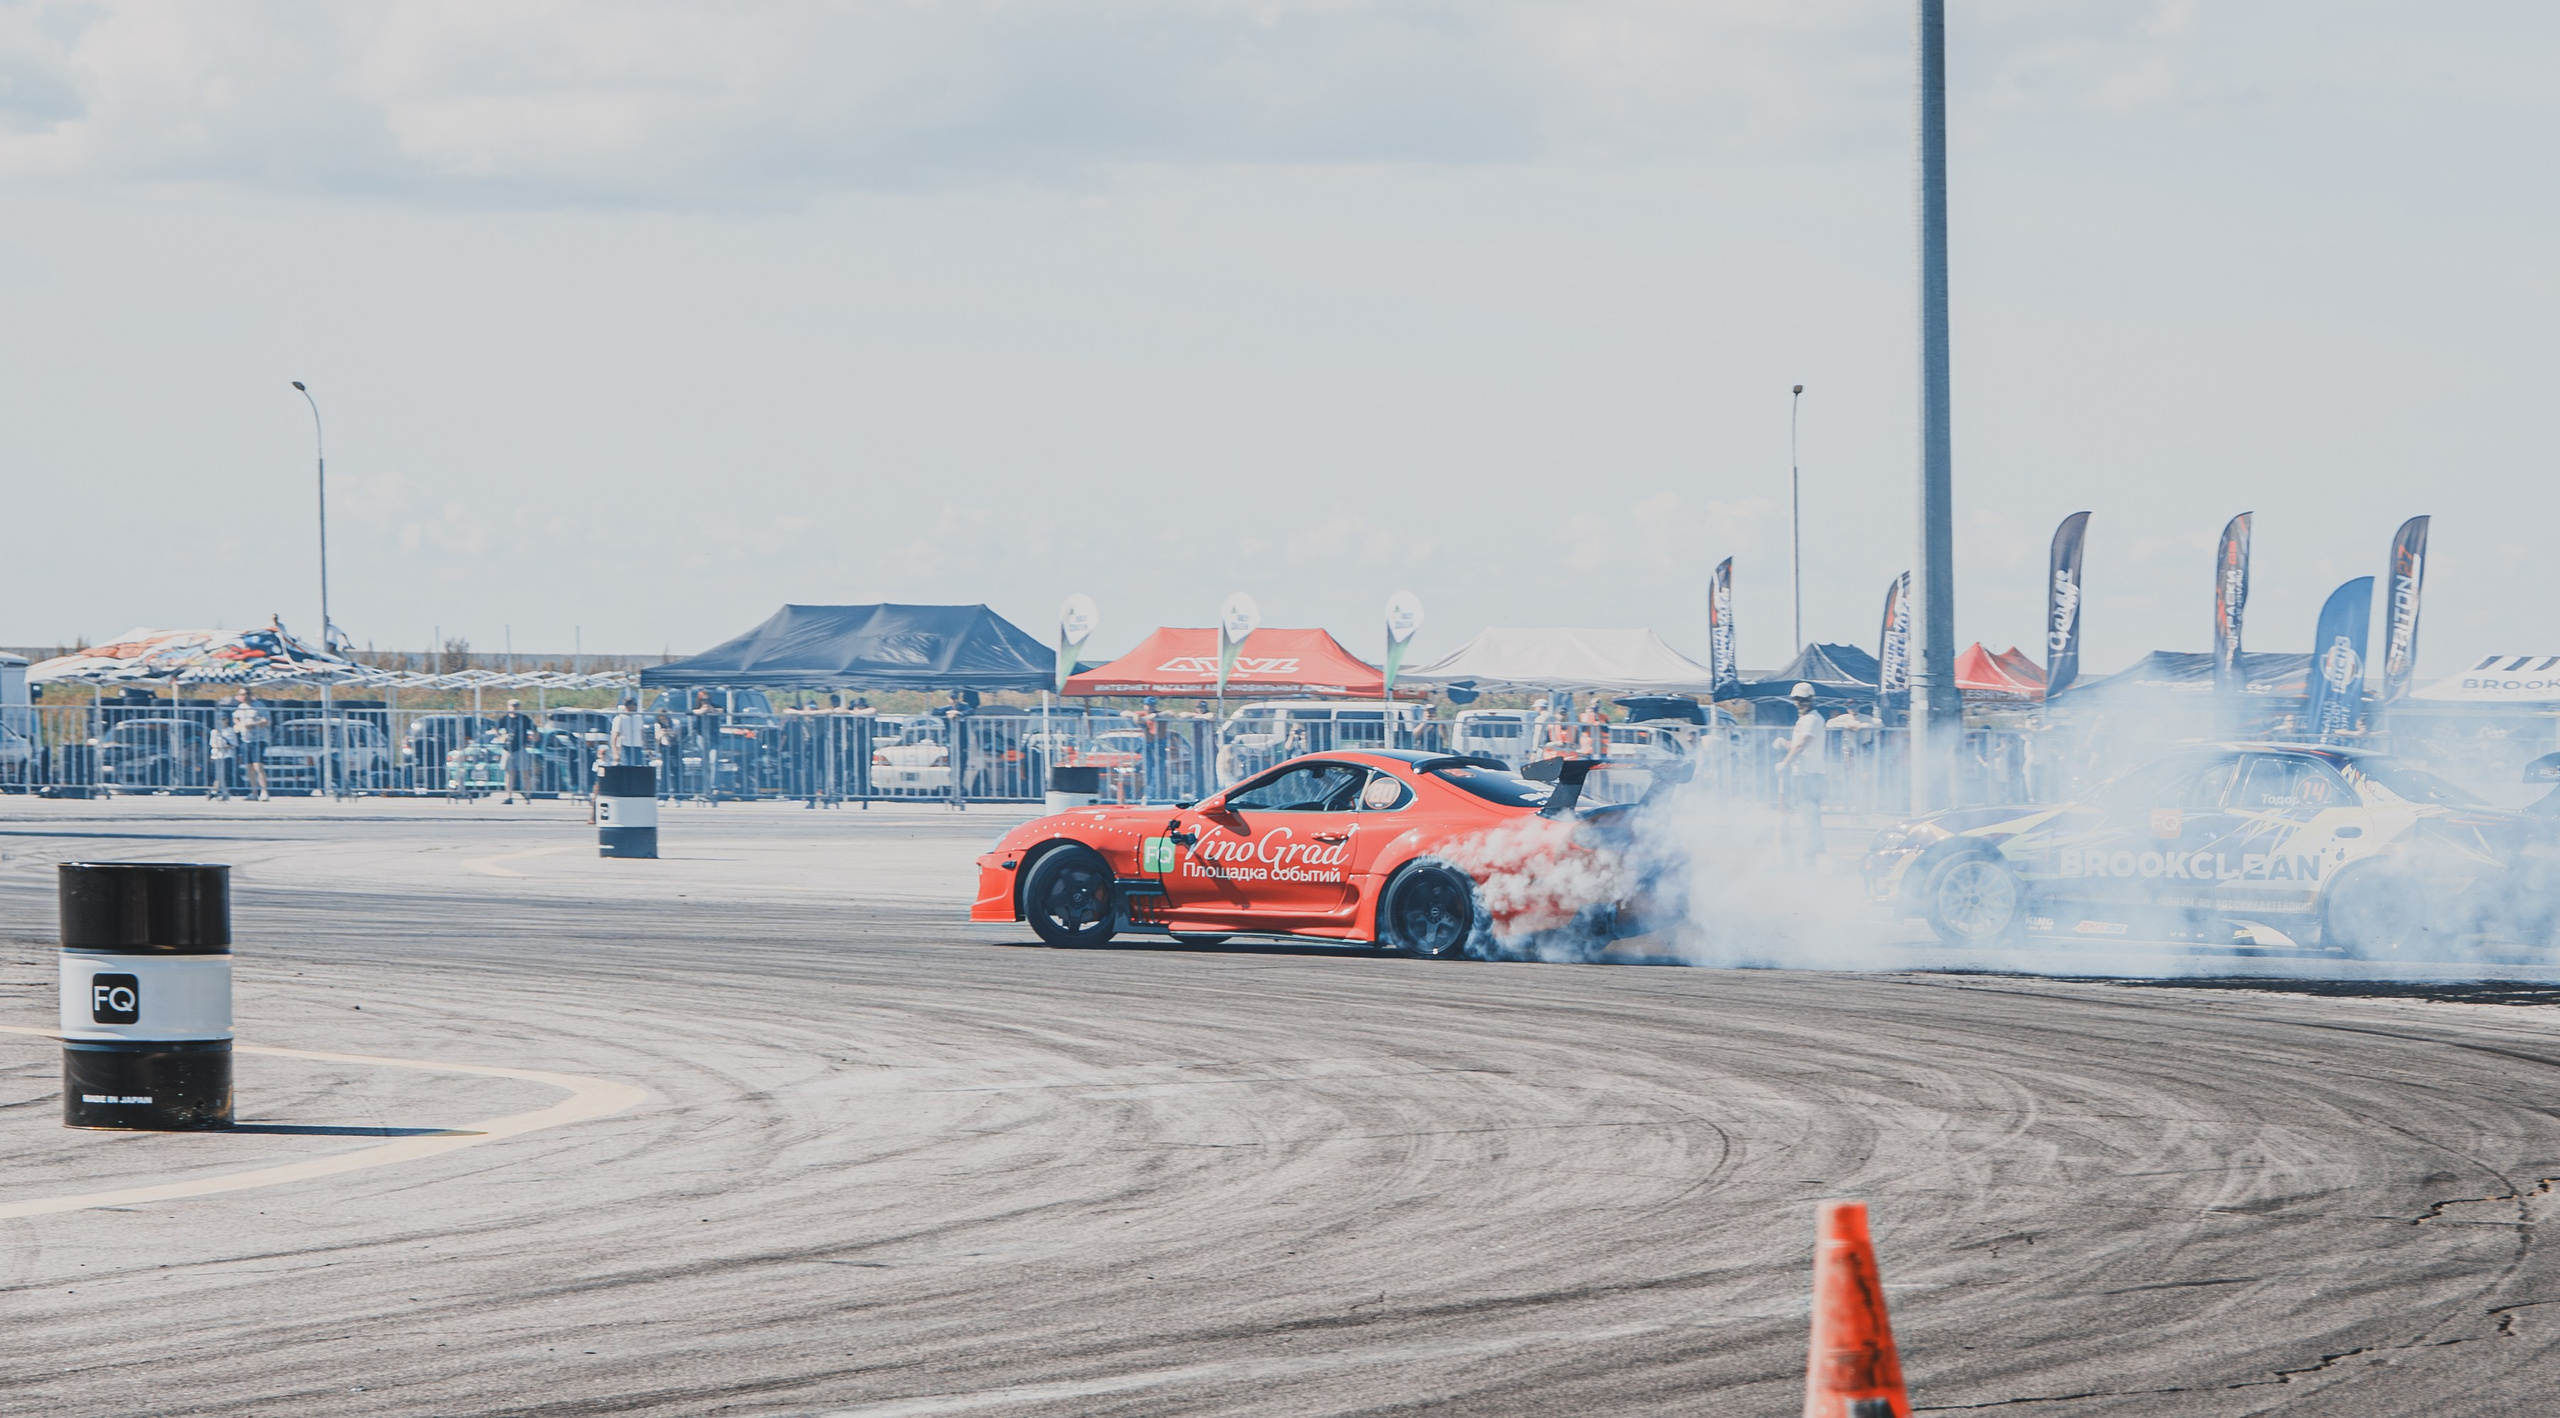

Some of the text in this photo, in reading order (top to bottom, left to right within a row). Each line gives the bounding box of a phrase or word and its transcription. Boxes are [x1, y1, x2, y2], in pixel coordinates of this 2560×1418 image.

[1369, 783, 1397, 803] 80
[2303, 781, 2326, 801] 14
[2152, 815, 2180, 830] FQ
[1145, 845, 1173, 865] FQ
[1183, 862, 1341, 883] Площадка событий
[2061, 851, 2320, 881] BROOKCLEAN
[94, 986, 135, 1011] FQ
